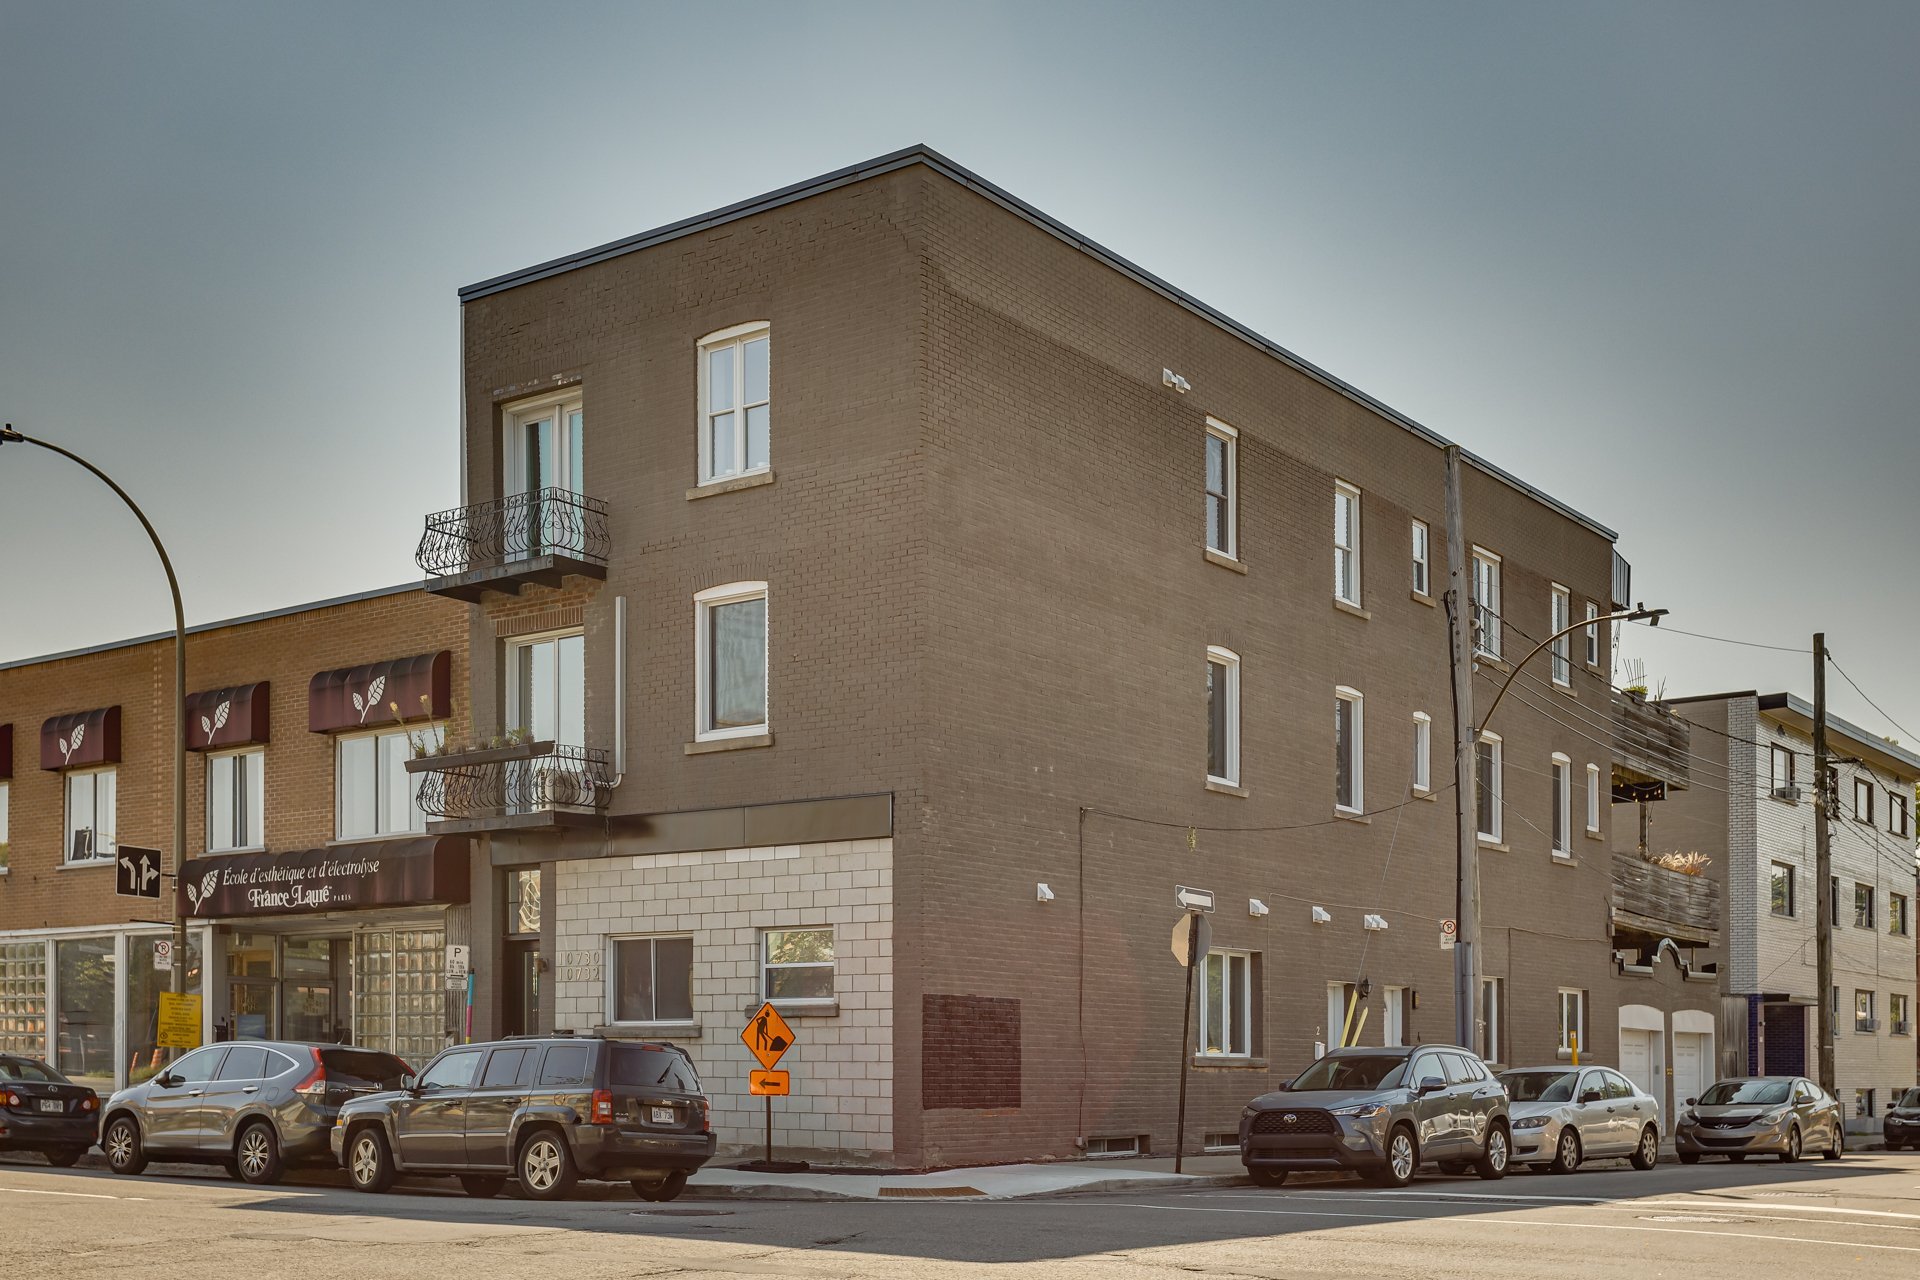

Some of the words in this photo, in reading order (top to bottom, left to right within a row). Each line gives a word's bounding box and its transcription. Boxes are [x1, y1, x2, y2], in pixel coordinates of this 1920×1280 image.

[223, 867, 248, 886] École
[250, 865, 305, 885] d'esthétique
[307, 865, 317, 878] et
[319, 857, 380, 878] d'électrolyse
[248, 888, 291, 908] France
[333, 894, 352, 902] PARIS
[454, 947, 462, 958] P
[559, 952, 600, 966] 10730
[559, 967, 600, 981] 10732
[1316, 1026, 1321, 1036] 2
